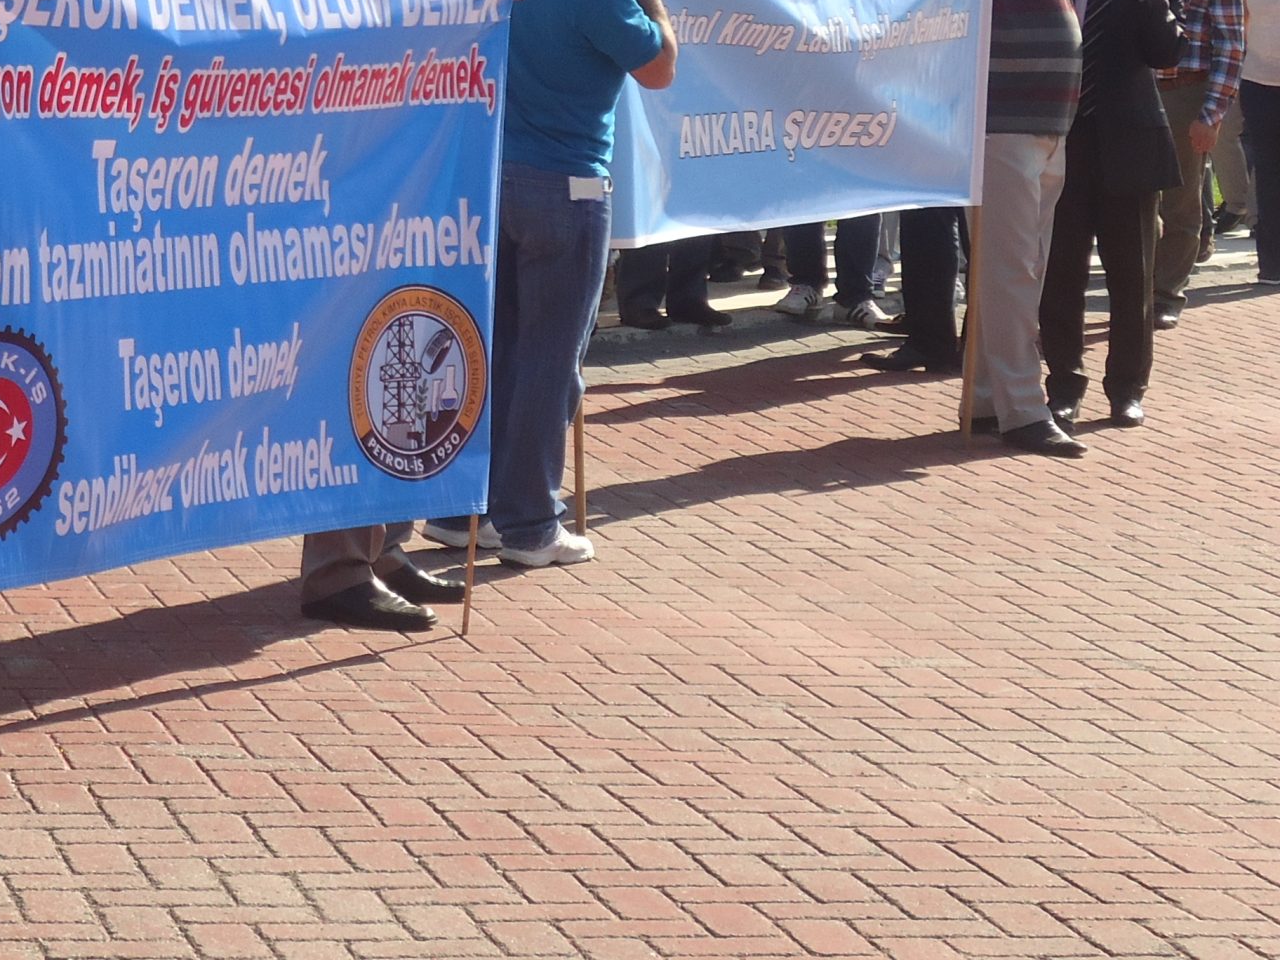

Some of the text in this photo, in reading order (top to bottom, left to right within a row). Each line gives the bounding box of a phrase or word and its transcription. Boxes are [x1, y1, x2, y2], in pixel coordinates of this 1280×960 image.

[664, 6, 723, 46] etrol
[716, 11, 796, 56] Kimya
[794, 16, 854, 54] Lastik
[37, 52, 145, 133] demek,
[148, 55, 181, 133] iş
[177, 52, 318, 133] güvencesi
[312, 49, 415, 114] olmamak
[410, 42, 496, 117] demek,
[678, 98, 898, 162] ANKARA ŞUBESİ
[92, 133, 330, 233] Taşeron demek,
[39, 219, 221, 304] tazminatının
[229, 212, 375, 287] olmaması
[375, 197, 492, 283] demek,
[118, 322, 303, 428] Taşeron demek,
[55, 420, 359, 537] sendikasız olmak demek...
[430, 432, 460, 465] 1950
